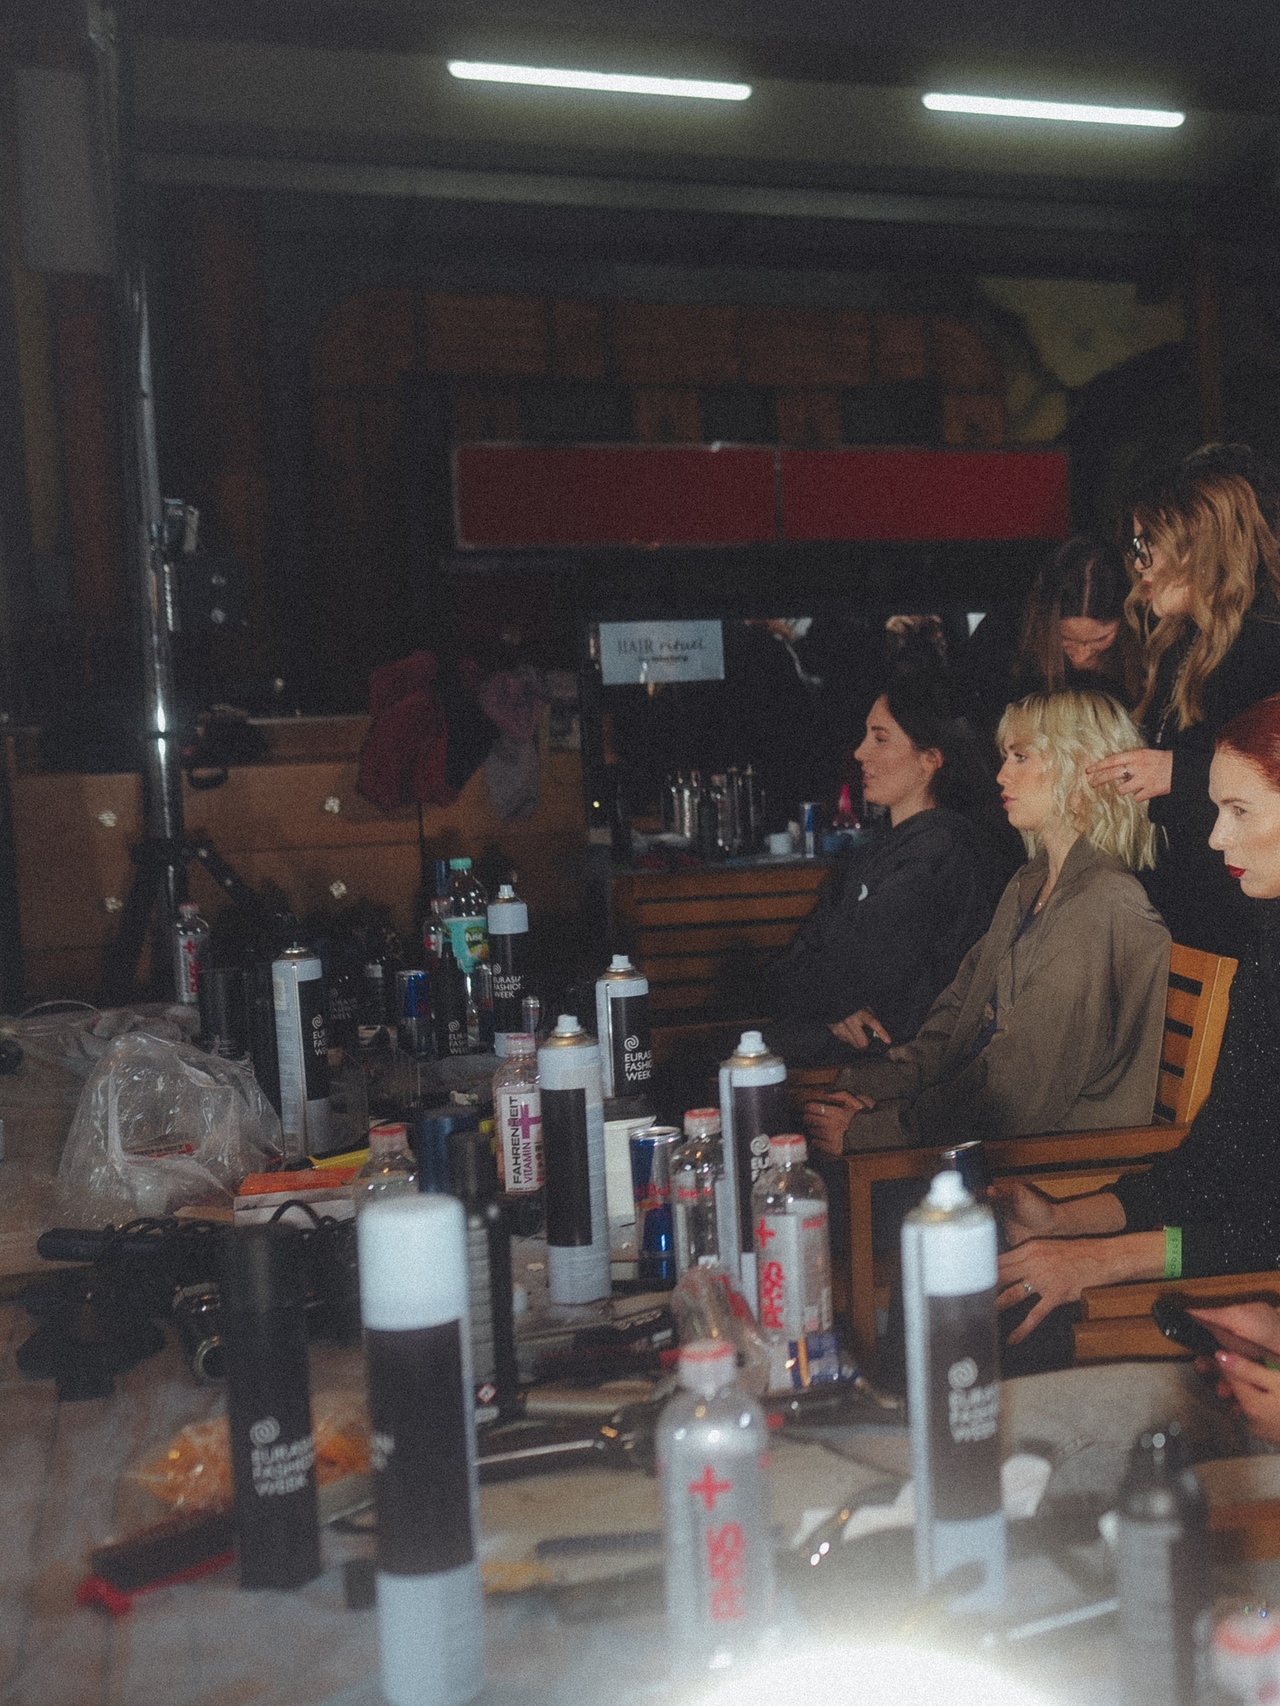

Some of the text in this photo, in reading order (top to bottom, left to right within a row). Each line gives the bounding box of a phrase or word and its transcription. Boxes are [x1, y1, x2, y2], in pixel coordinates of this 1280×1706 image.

[625, 1070, 652, 1082] WEEK
[509, 1096, 523, 1185] FAHRENHEIT
[521, 1142, 533, 1184] VITAMIN
